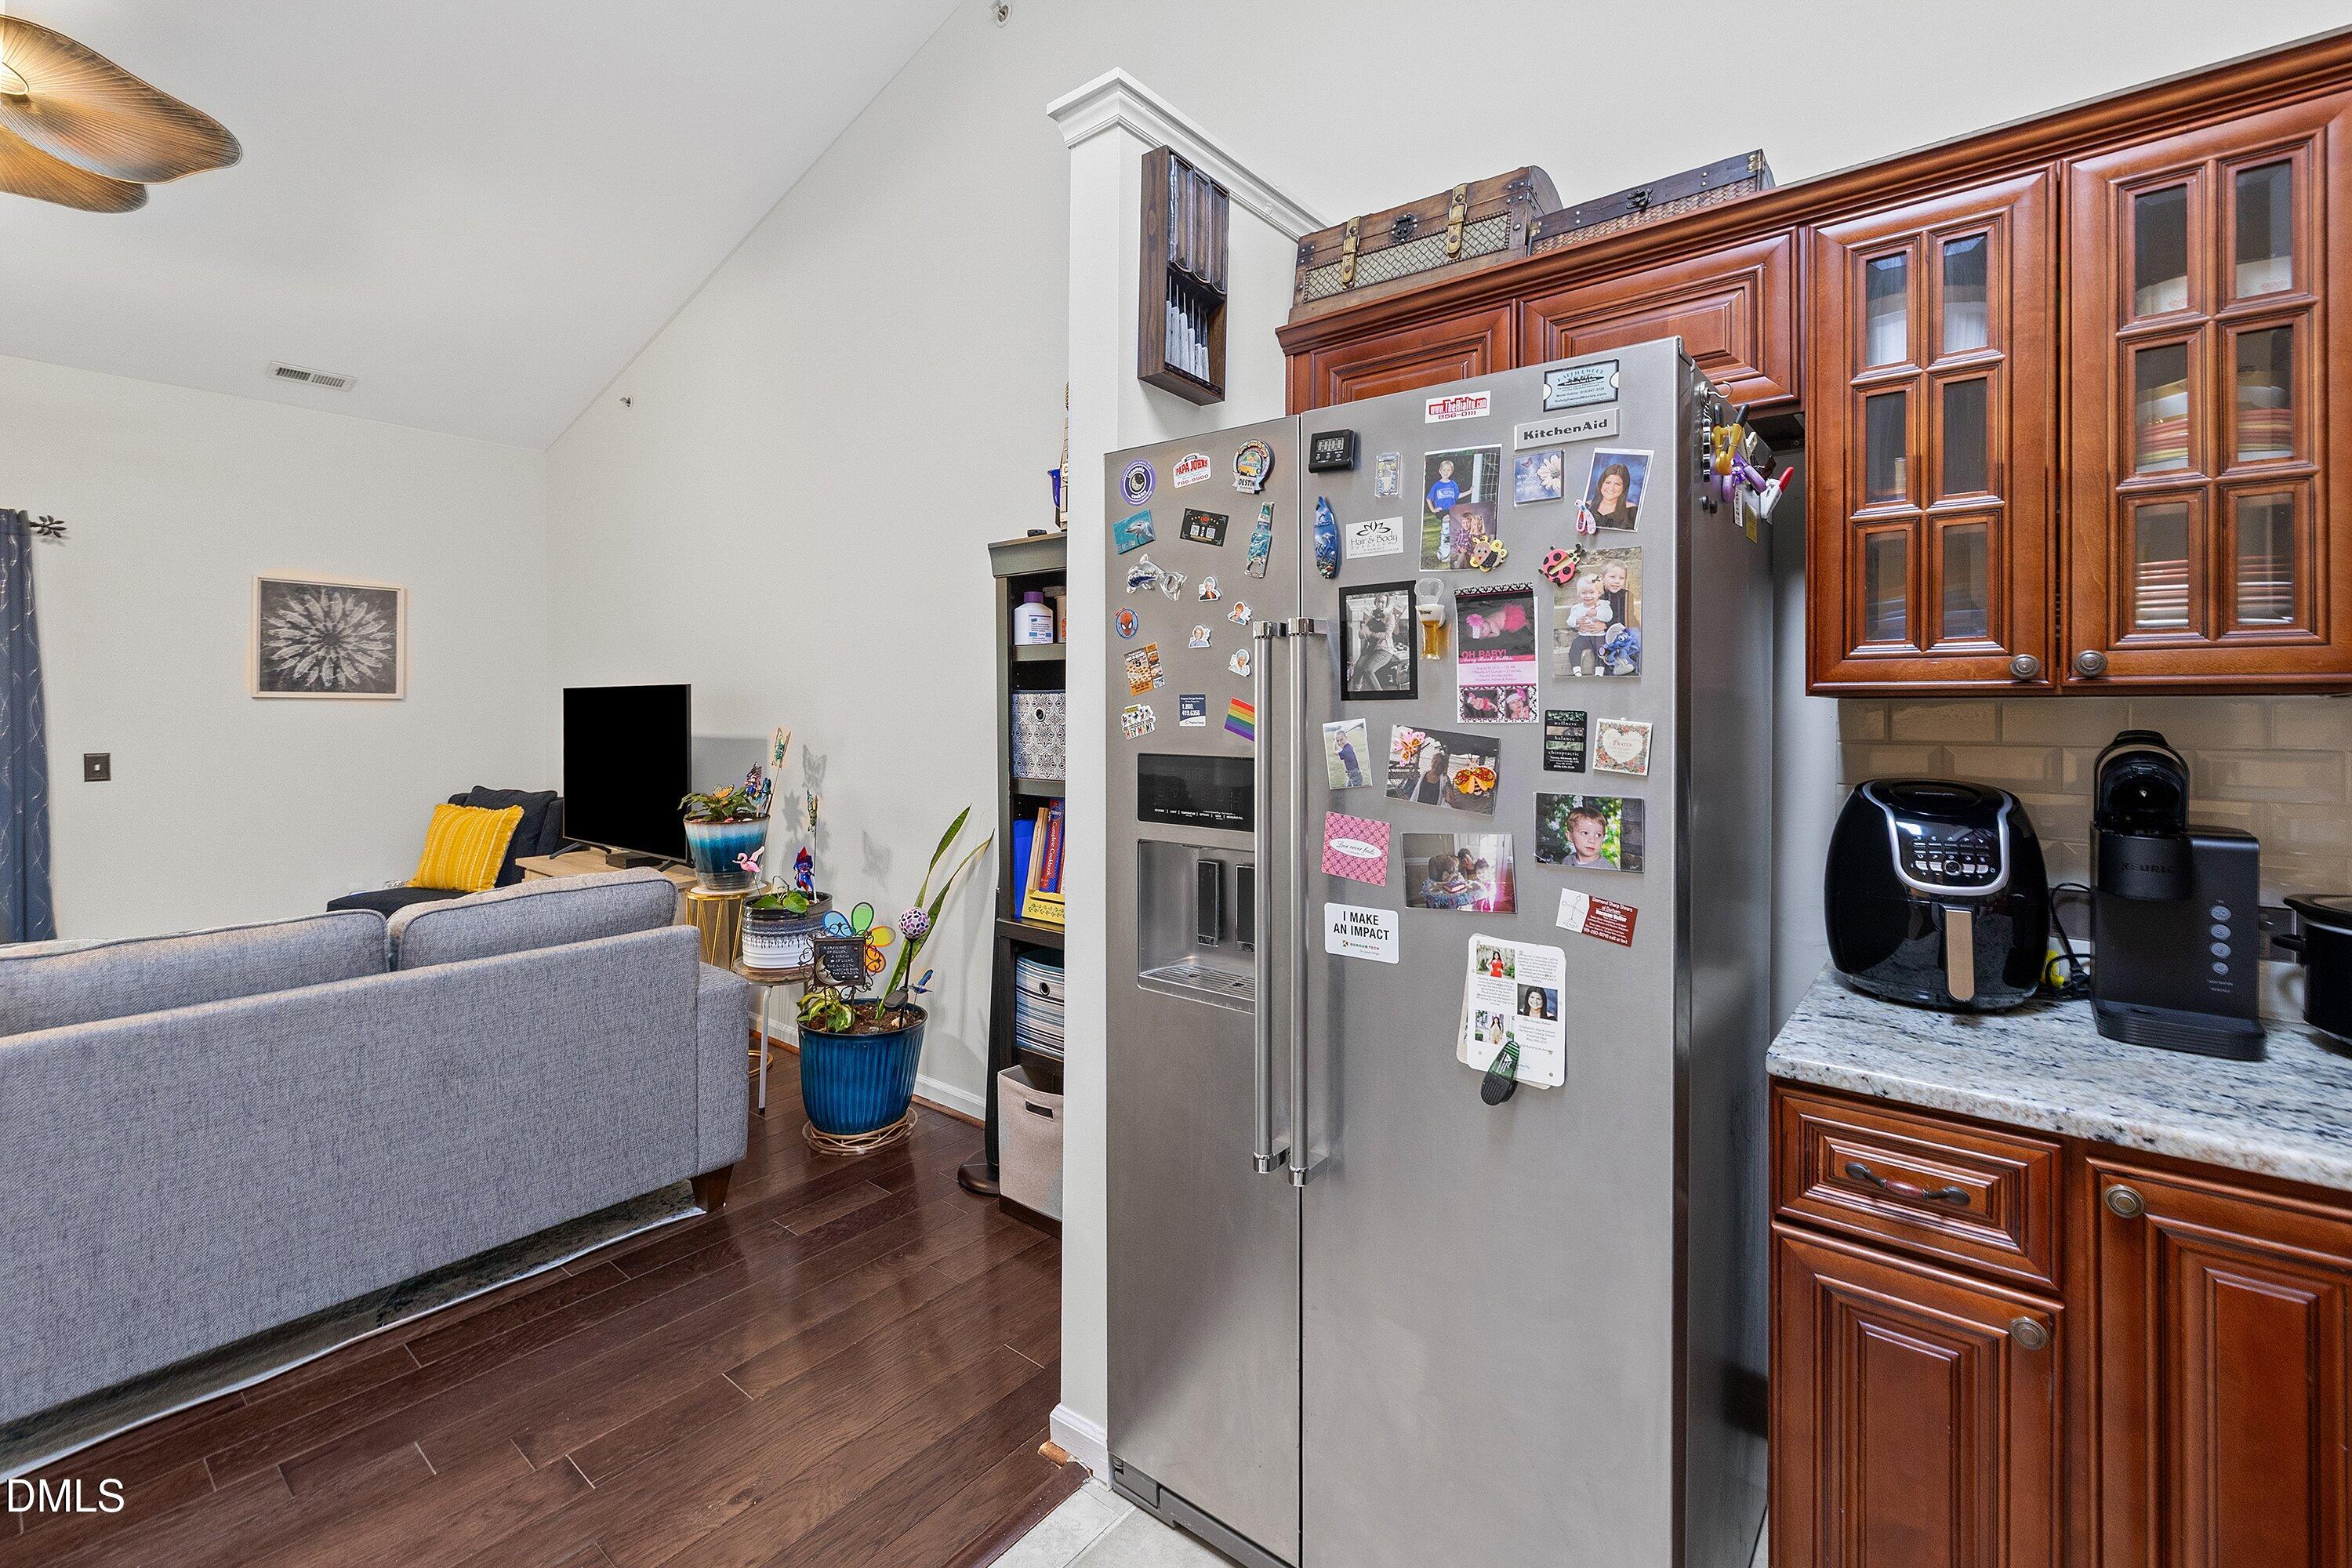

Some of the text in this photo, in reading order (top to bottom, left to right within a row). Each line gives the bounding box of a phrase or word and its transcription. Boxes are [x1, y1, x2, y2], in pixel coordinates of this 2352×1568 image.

[1429, 397, 1487, 416] www.TheRialto.com
[1523, 419, 1607, 441] KitchenAid
[1368, 535, 1375, 544] &
[1376, 530, 1398, 545] Body
[1478, 649, 1507, 658] BABY!
[1047, 849, 1055, 877] Cookbook
[1343, 911, 1379, 926] I MAKE
[1333, 923, 1390, 941] AN IMPACT
